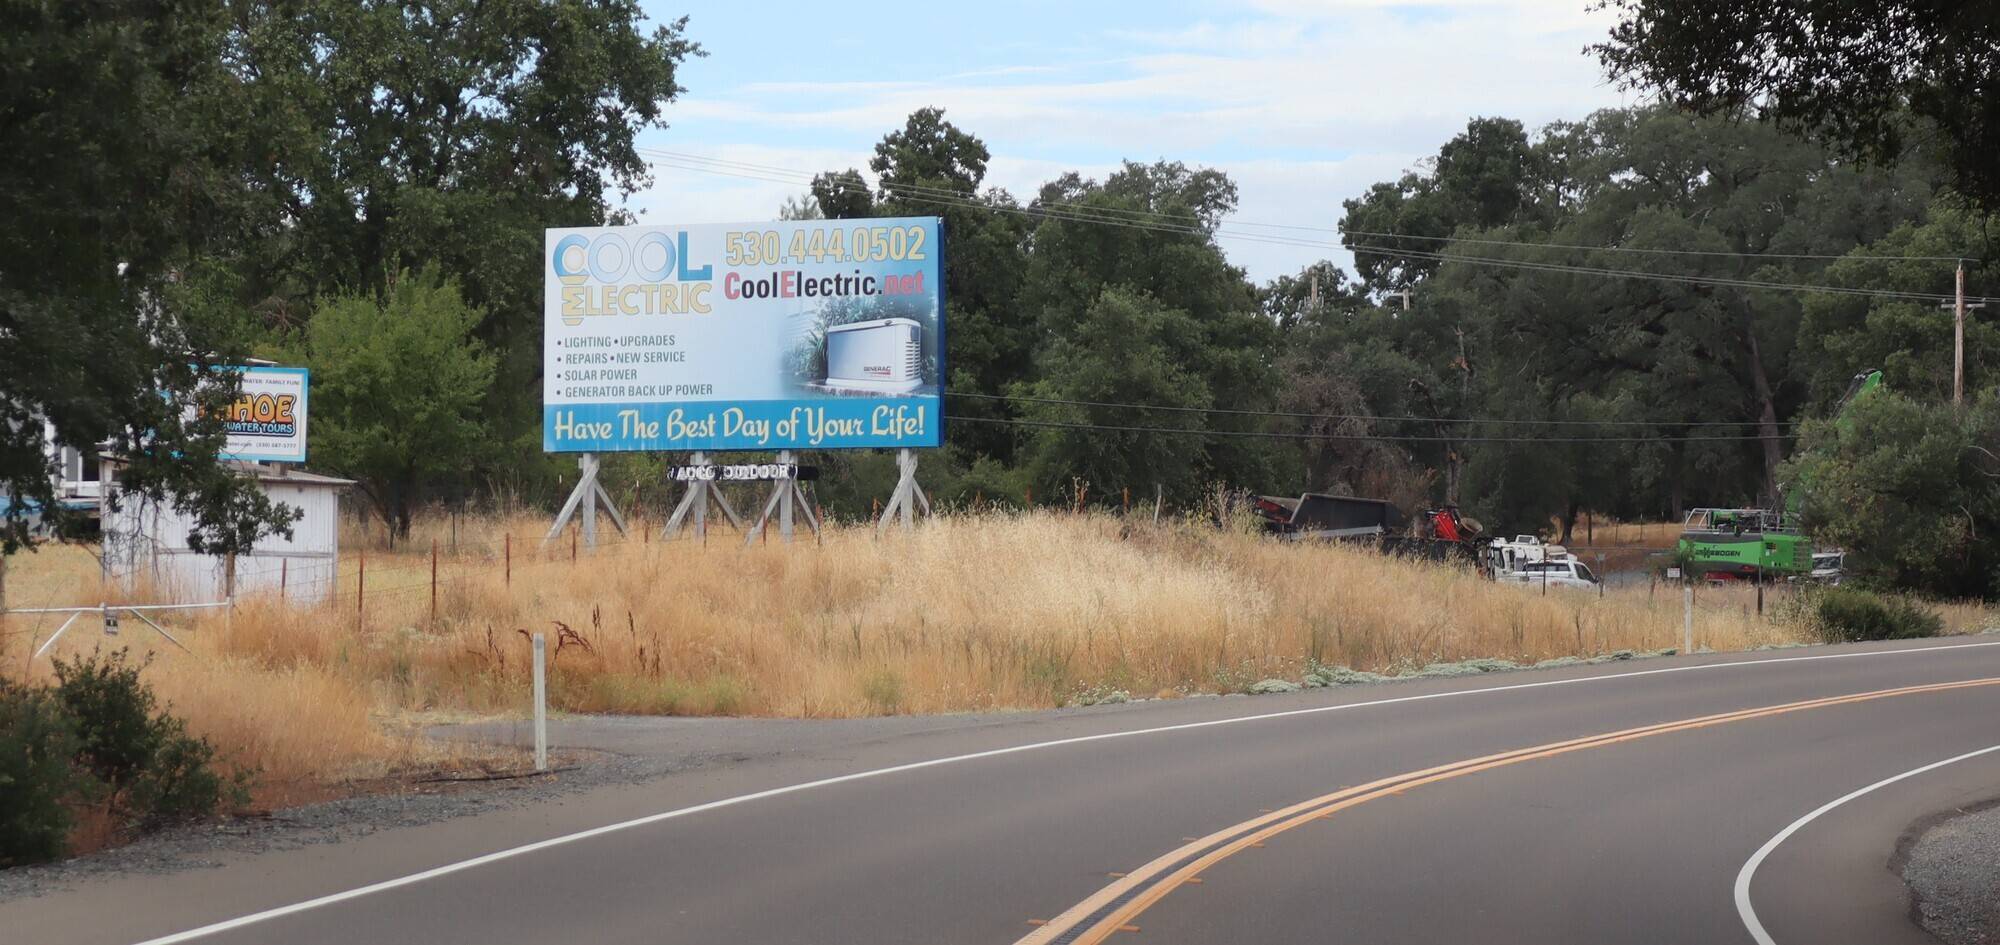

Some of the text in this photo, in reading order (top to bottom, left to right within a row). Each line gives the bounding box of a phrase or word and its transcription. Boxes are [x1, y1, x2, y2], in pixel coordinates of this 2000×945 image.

[553, 231, 712, 284] COOL
[725, 225, 926, 267] 530.444.0502
[562, 282, 713, 316] ELECTRIC
[724, 269, 924, 300] CoolElectric.net
[564, 335, 675, 348] LIGHTING UPGRADES
[565, 351, 686, 365] REPAIRS NEW SERVICE
[564, 368, 637, 381] SOLAR POWER
[565, 383, 713, 398] GENERATOR BACK UP POWER
[197, 393, 296, 423] HOE
[261, 423, 293, 433] TOURS
[554, 405, 925, 445] Have The Best Day of Your Life!
